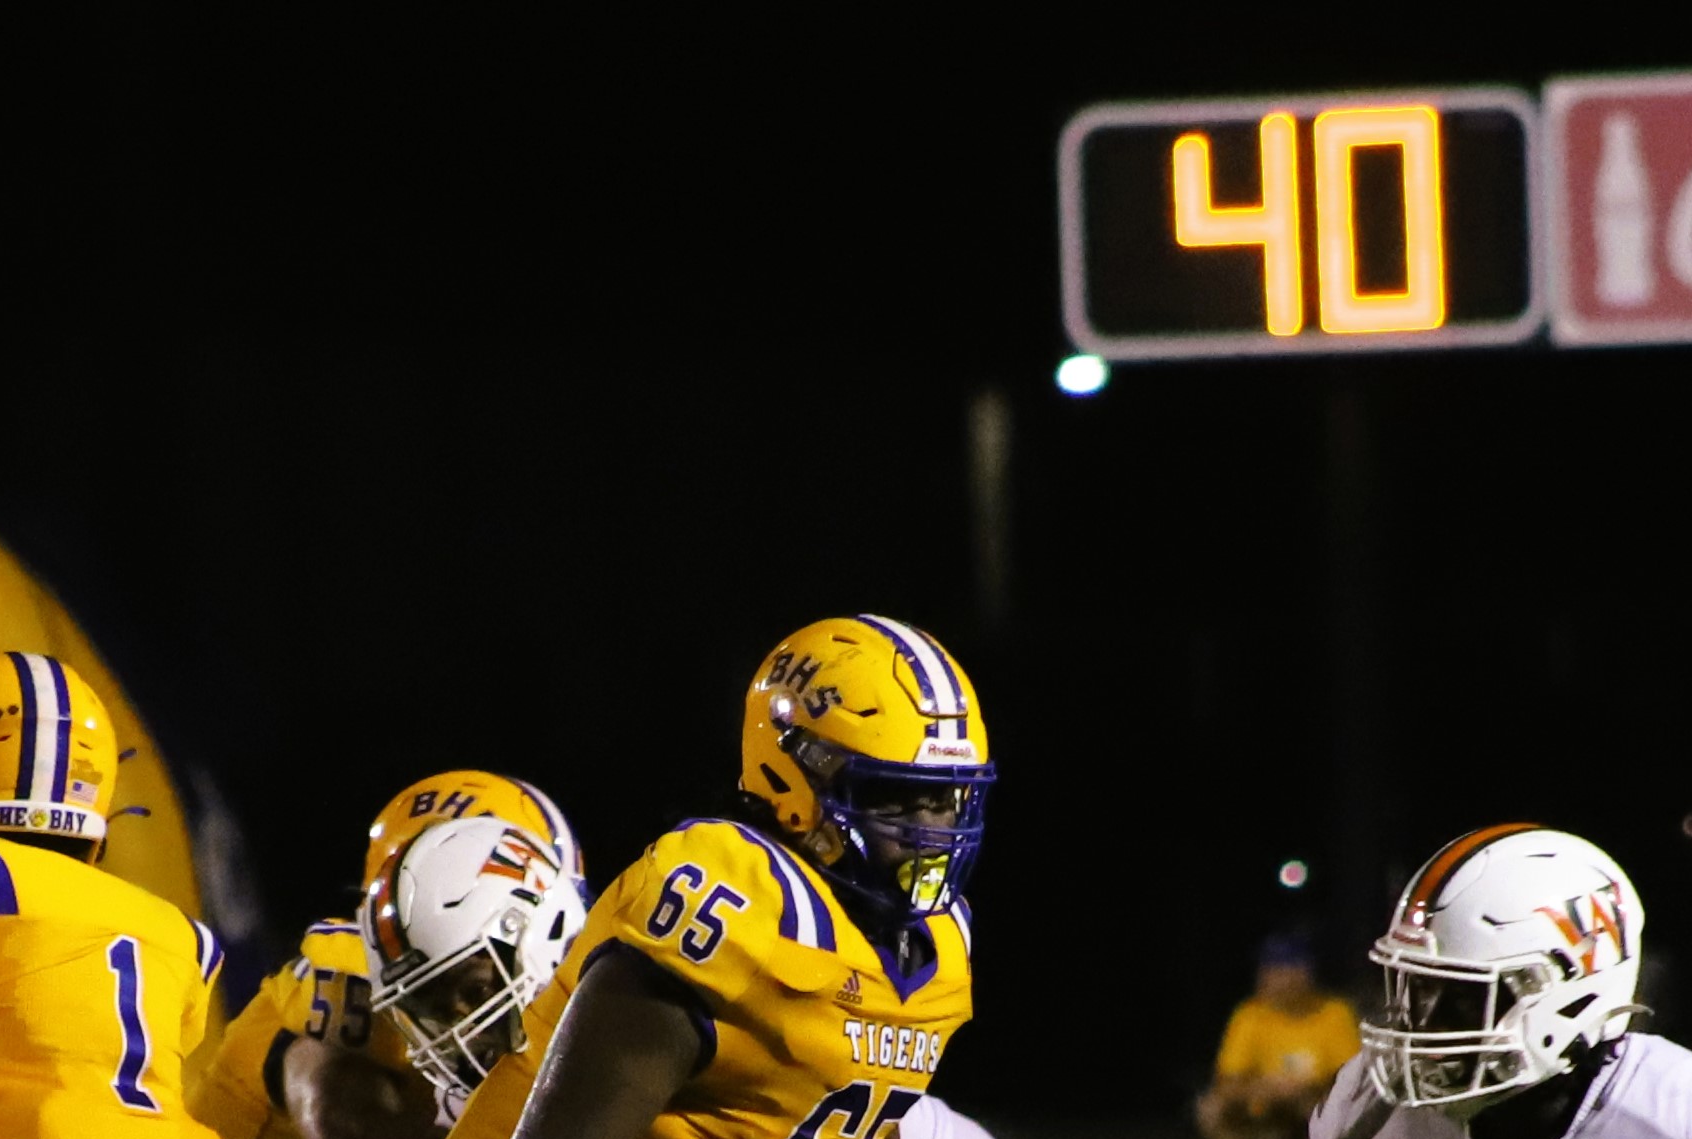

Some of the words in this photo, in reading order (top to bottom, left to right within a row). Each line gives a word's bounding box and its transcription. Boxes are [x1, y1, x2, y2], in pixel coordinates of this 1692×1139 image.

[1172, 111, 1446, 337] 40
[767, 652, 843, 719] BHS
[49, 812, 88, 835] BAY
[409, 790, 495, 819] BH
[645, 862, 747, 966] 65
[105, 934, 162, 1113] 1
[304, 967, 374, 1048] 55
[842, 1018, 941, 1074] TIGERS
